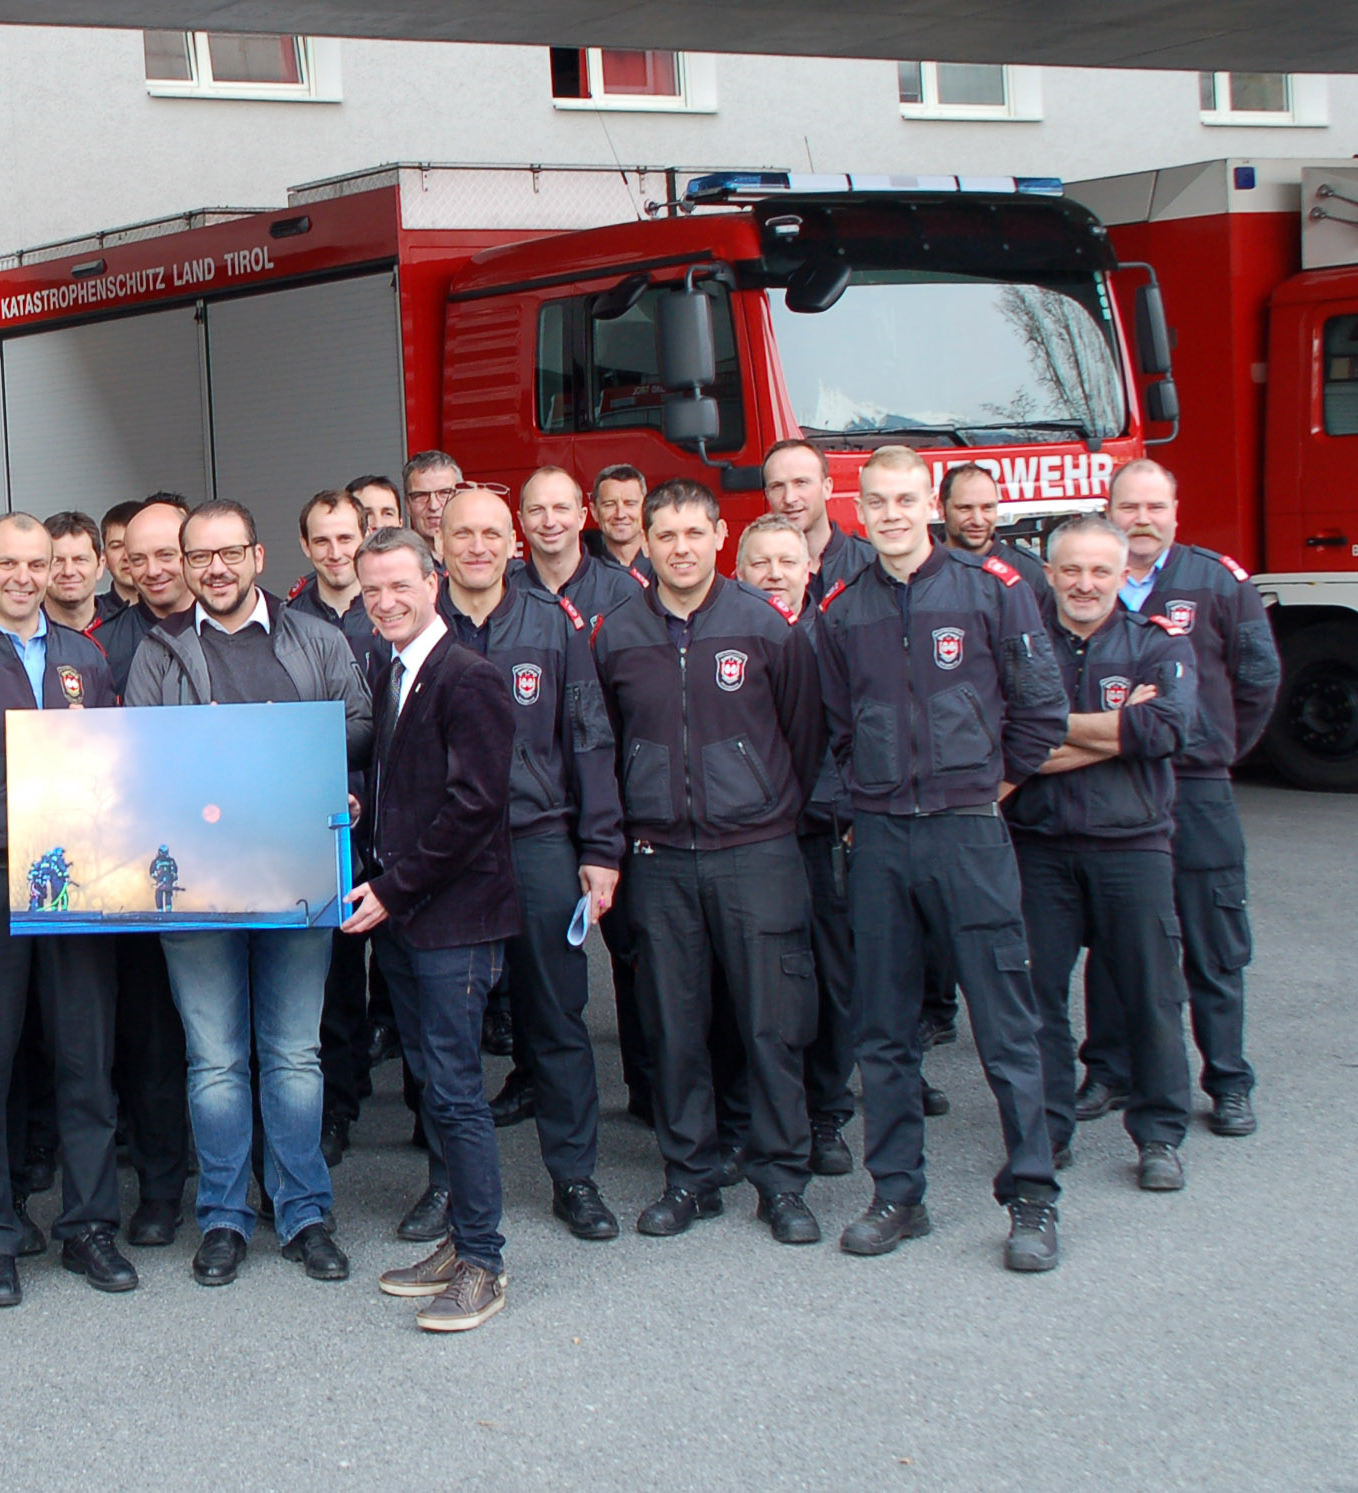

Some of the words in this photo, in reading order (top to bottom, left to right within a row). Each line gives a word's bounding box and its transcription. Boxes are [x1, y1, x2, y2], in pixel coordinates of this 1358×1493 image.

[0, 266, 165, 320] KATASTROPHENSCHUTZ
[173, 257, 216, 286] LAND
[224, 246, 274, 276] TIROL
